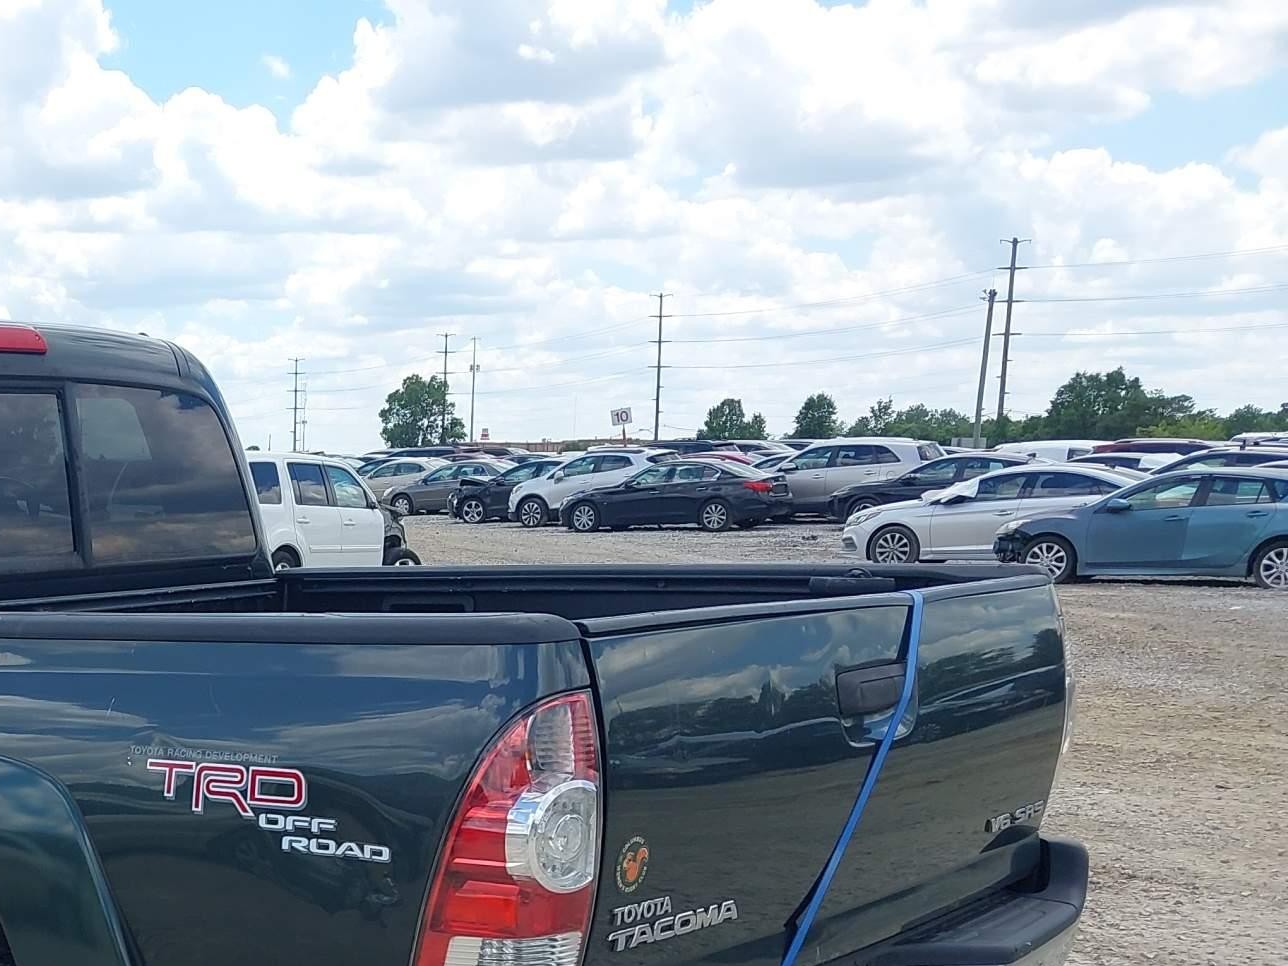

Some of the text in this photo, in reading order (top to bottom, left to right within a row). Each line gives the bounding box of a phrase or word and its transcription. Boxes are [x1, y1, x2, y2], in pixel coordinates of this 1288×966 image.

[613, 411, 629, 423] 10
[130, 744, 280, 765] TOYOTA RACING DEVELOPMENT
[147, 758, 307, 817] TRD
[258, 813, 337, 834] OFF
[281, 836, 392, 863] ROAD
[614, 896, 672, 927] TOYOTA
[608, 900, 739, 952] TACOMA
